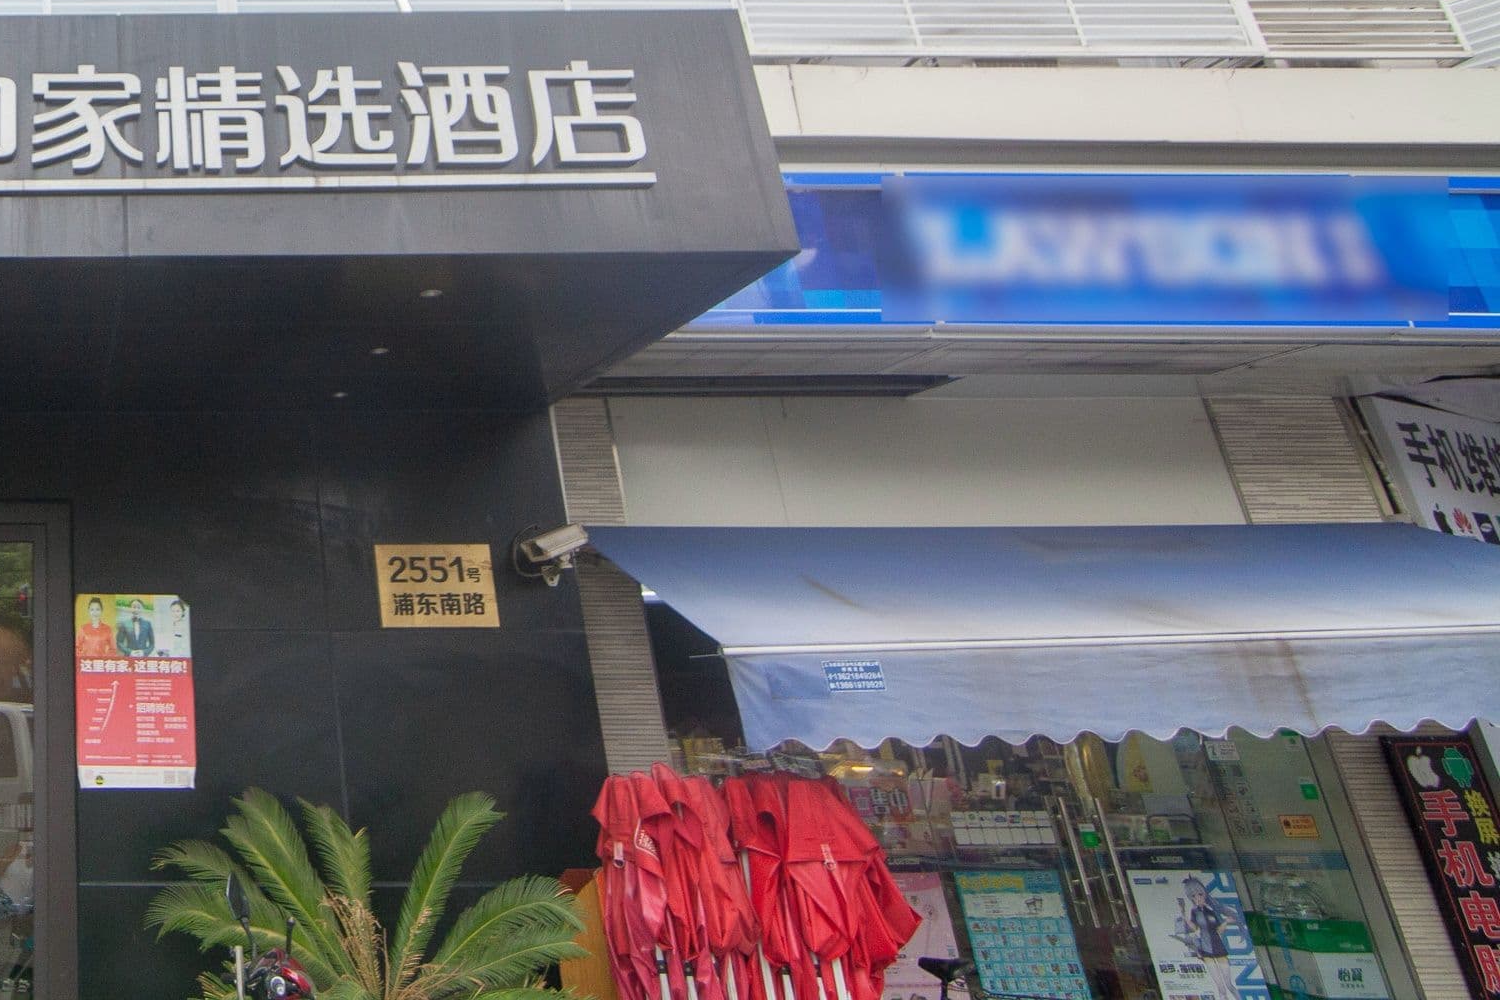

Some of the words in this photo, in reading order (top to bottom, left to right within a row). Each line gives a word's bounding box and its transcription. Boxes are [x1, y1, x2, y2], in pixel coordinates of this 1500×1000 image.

[387, 556, 482, 583] 2551号
[392, 592, 485, 616] 浦东南路
